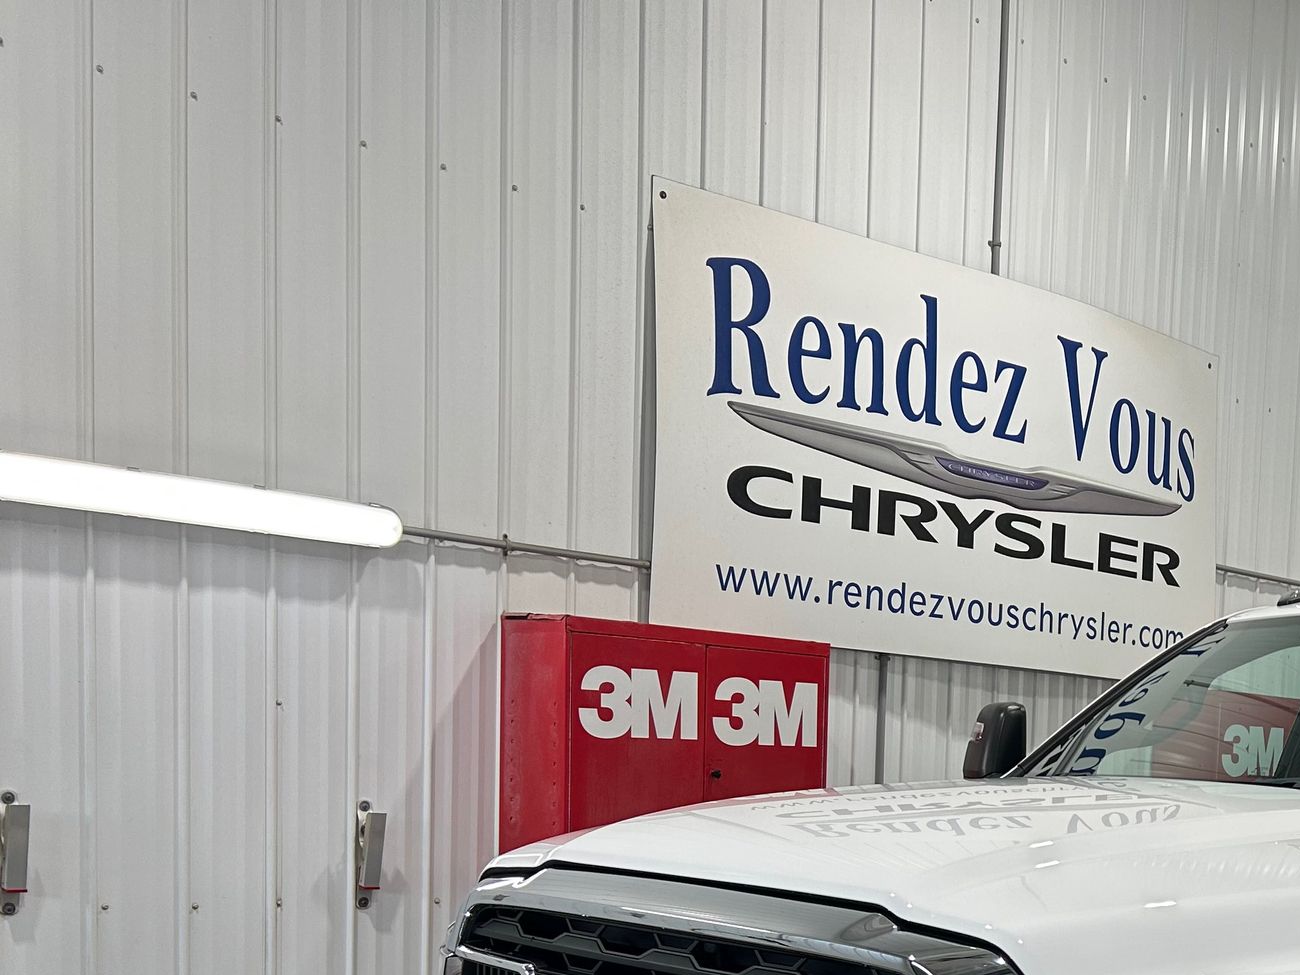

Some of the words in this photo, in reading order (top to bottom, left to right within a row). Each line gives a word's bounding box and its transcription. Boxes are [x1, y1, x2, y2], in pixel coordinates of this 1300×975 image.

[706, 256, 1028, 444] Rendez
[1057, 334, 1196, 503] Vous
[726, 465, 1181, 588] CHRYSLER
[715, 563, 1184, 650] www.rendezvouschrysler.com
[578, 665, 699, 740] 3M
[712, 676, 819, 748] 3M
[1221, 723, 1285, 778] 3M
